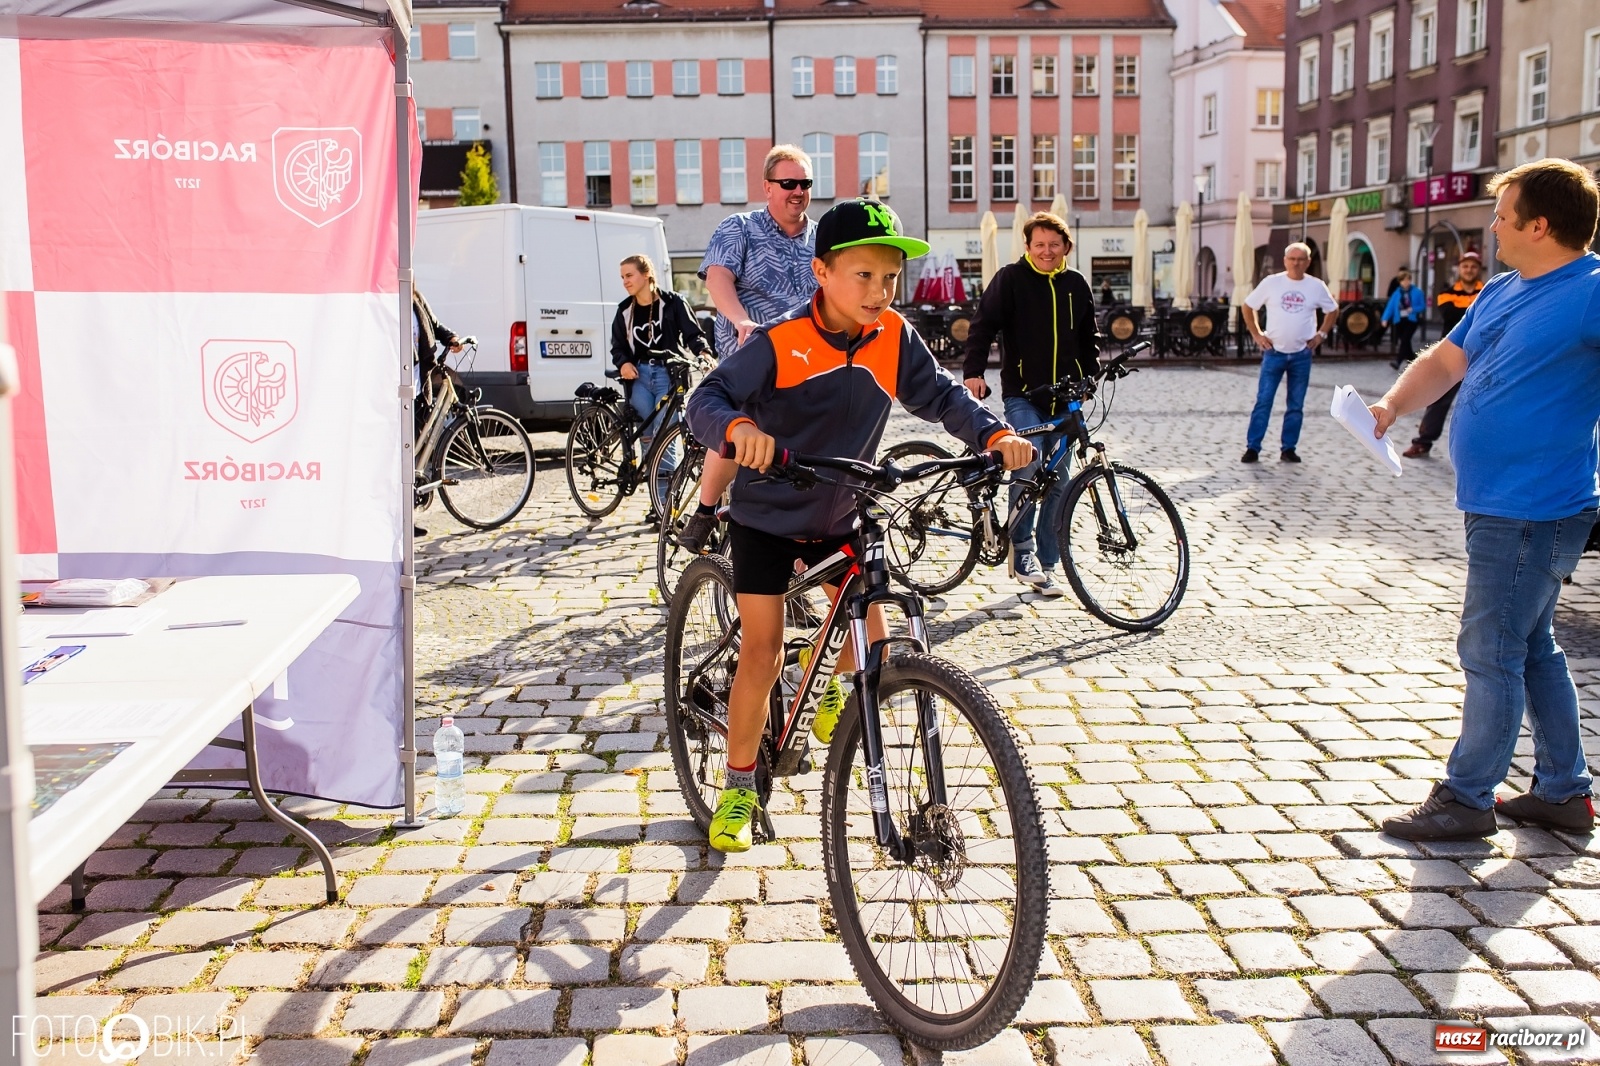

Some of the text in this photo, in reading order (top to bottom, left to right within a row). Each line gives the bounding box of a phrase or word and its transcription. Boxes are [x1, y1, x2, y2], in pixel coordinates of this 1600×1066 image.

[864, 204, 898, 236] NY
[547, 343, 590, 355] SRC 8K79
[850, 463, 874, 476] ZOOM
[918, 463, 941, 477] ZOOM
[788, 625, 850, 751] MAXBIKE
[825, 769, 838, 883] SCHWALBE
